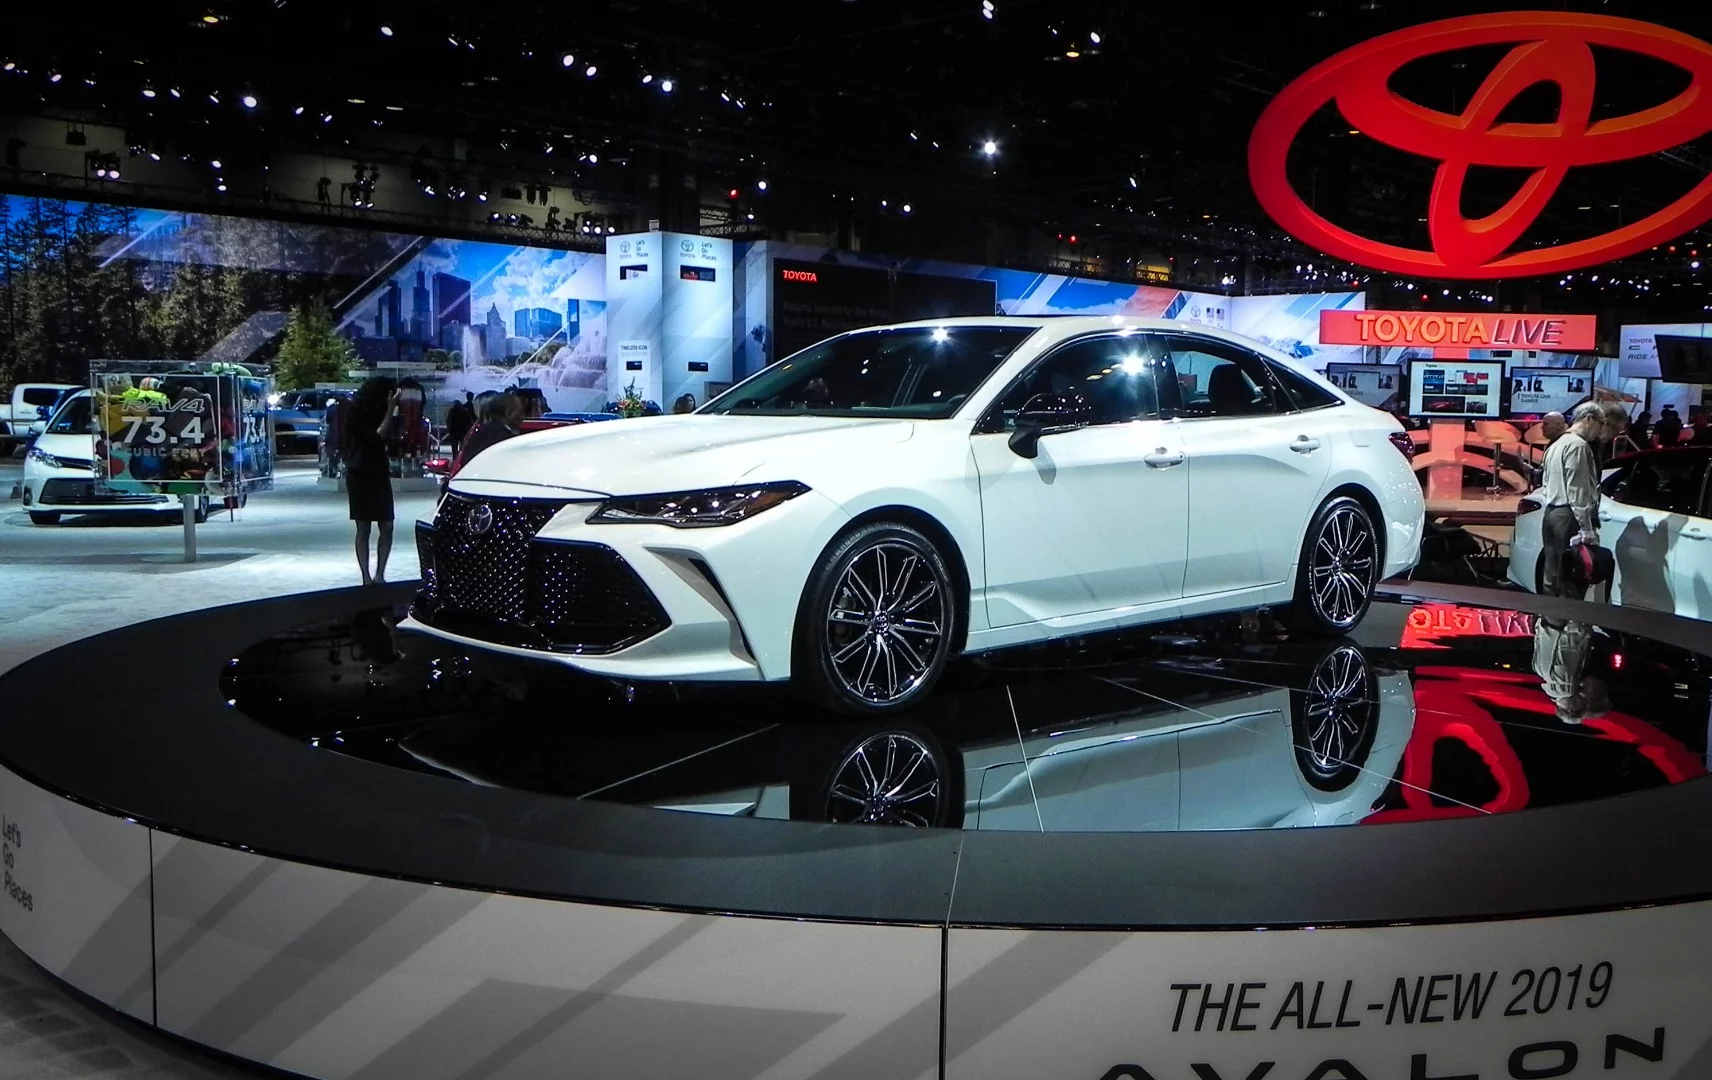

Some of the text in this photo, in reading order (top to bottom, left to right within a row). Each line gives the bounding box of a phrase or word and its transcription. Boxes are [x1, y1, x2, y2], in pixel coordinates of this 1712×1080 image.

[783, 270, 817, 281] TOYOTA
[1356, 314, 1567, 345] TOYOTA LIVE
[121, 398, 205, 414] RAV4
[121, 416, 205, 444] 73.4
[242, 416, 267, 444] 73.4
[3, 814, 21, 848] Let's
[3, 842, 14, 869] Go
[4, 870, 34, 912] Places
[1169, 961, 1614, 1032] THE ALL-NEW 2019
